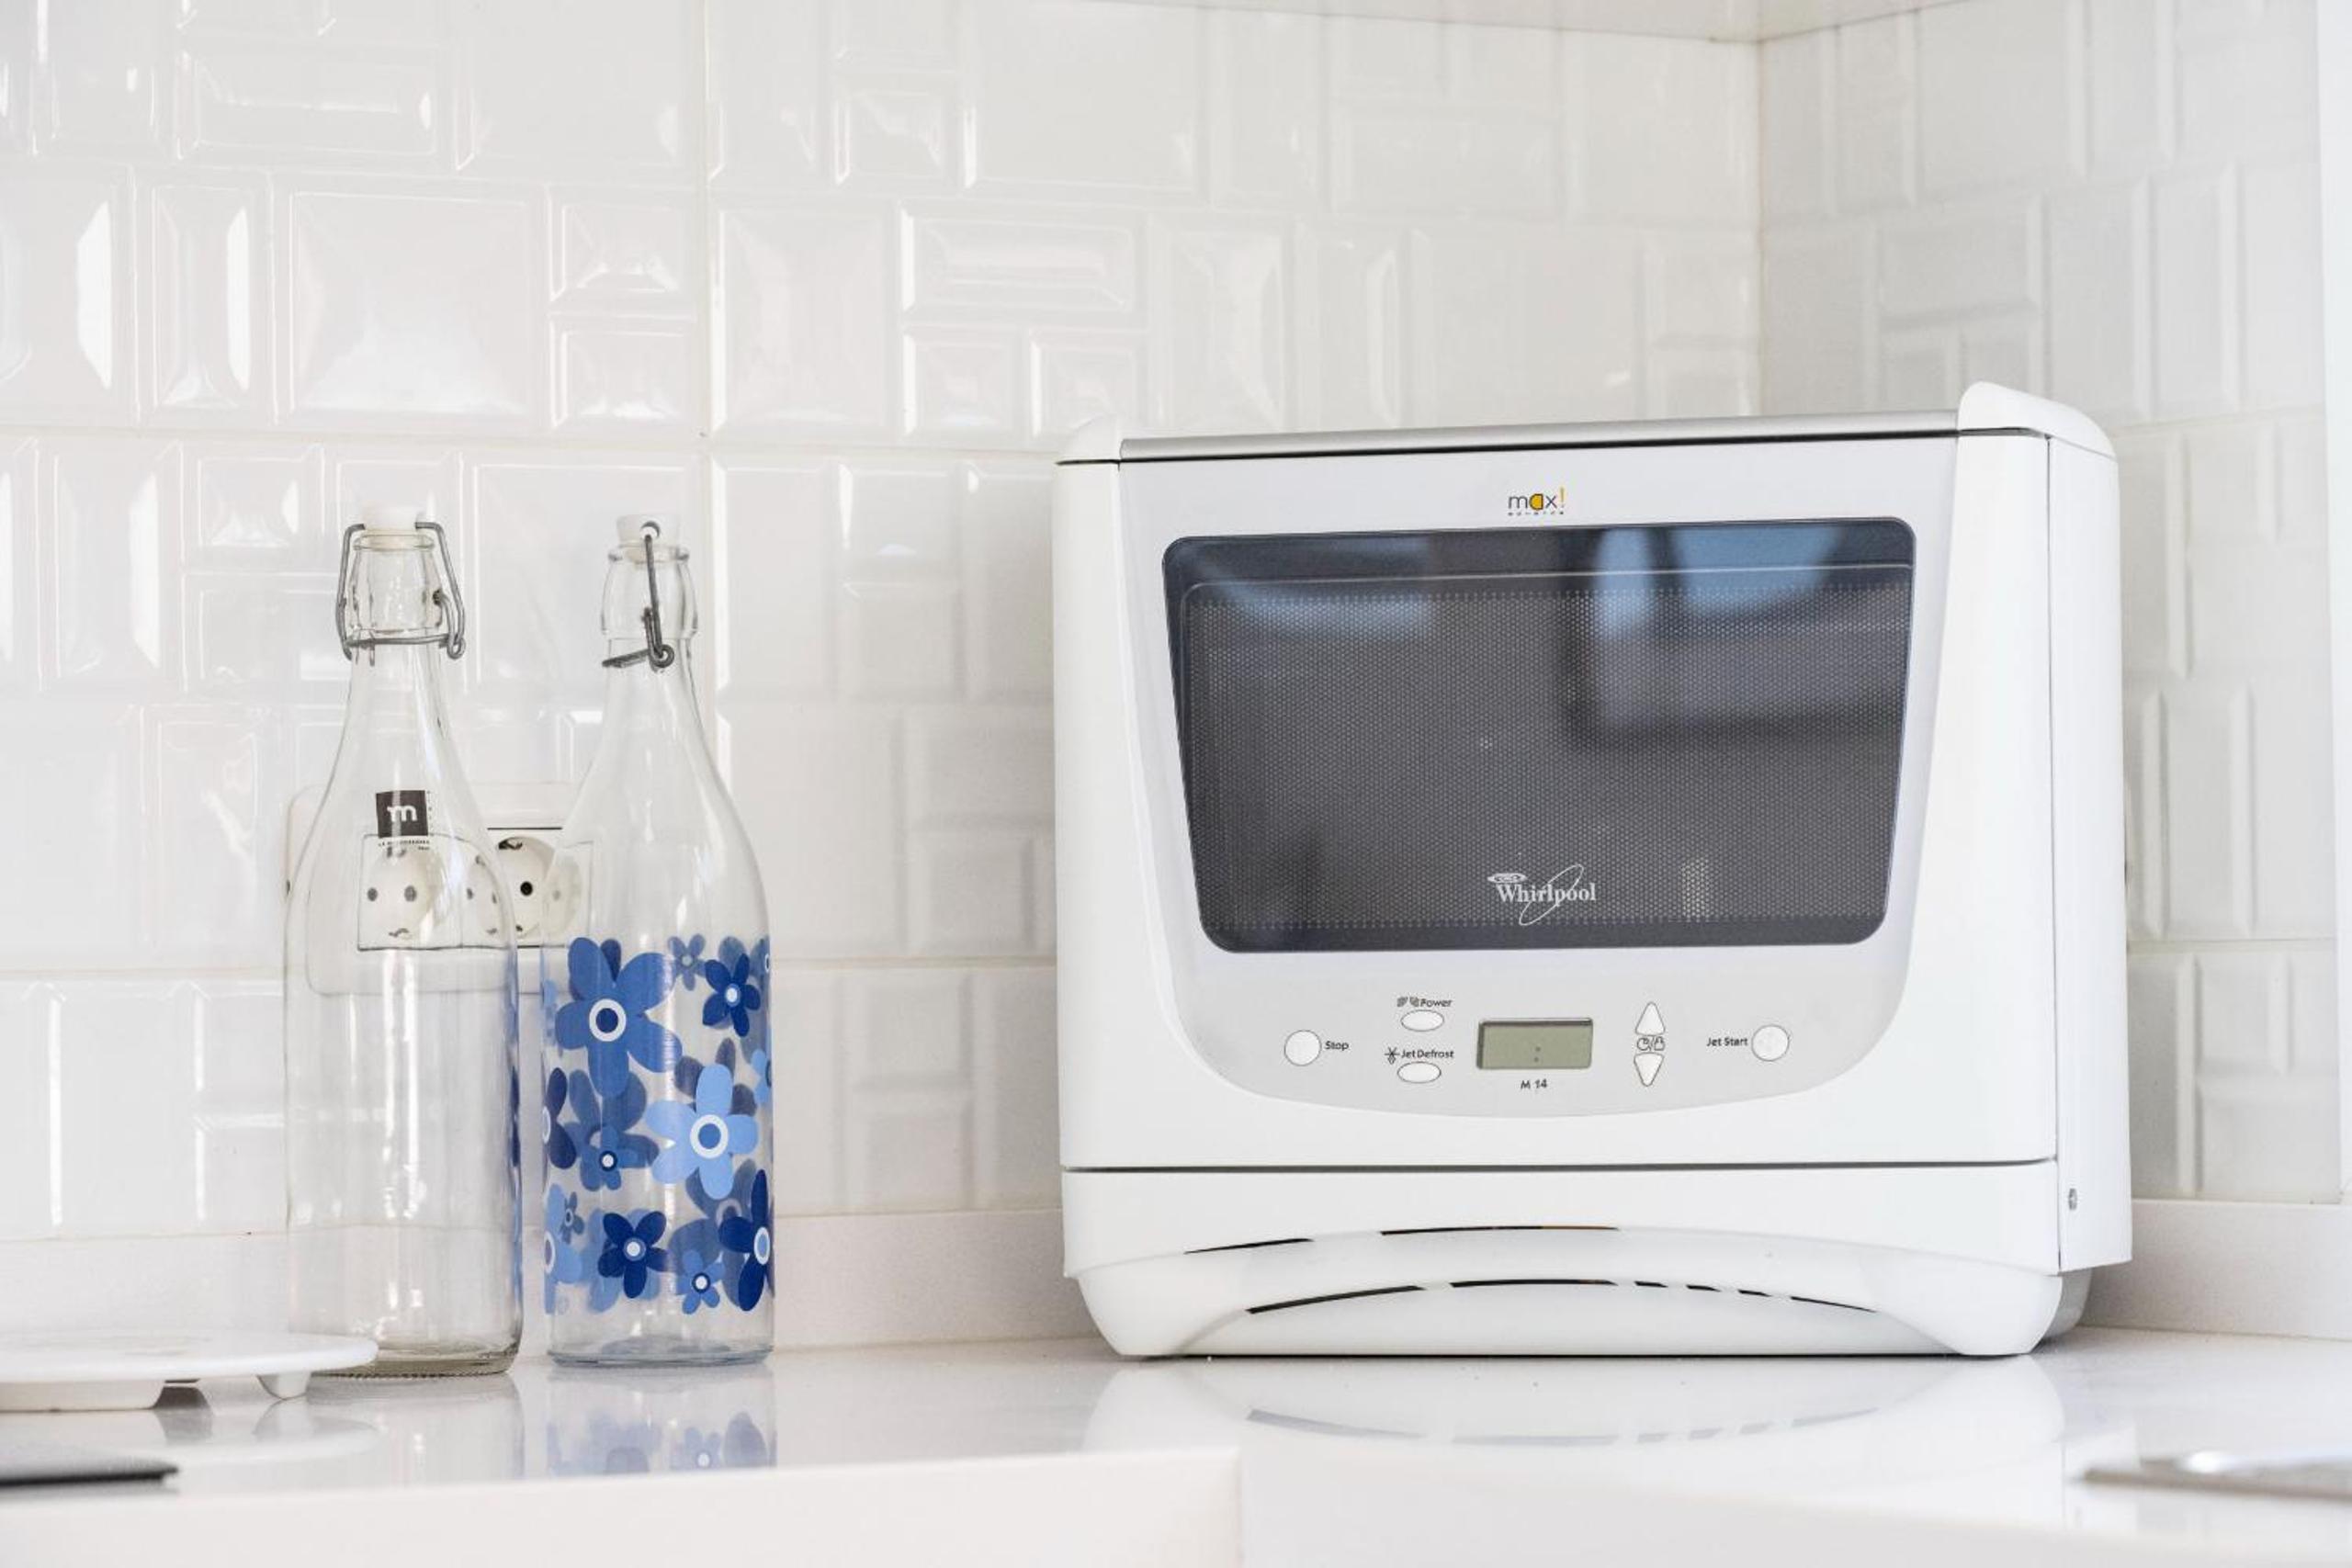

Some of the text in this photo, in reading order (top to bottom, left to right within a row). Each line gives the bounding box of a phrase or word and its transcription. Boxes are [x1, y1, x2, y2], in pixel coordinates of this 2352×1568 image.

[1508, 486, 1565, 511] max!
[387, 805, 418, 822] m
[1496, 882, 1597, 908] Whirlpool
[1420, 998, 1453, 1008] Power
[1325, 1040, 1350, 1051] Stop
[1706, 1036, 1748, 1047] Jet Start
[1401, 1048, 1454, 1059] Jet Defrost
[1520, 1078, 1548, 1089] M 14
